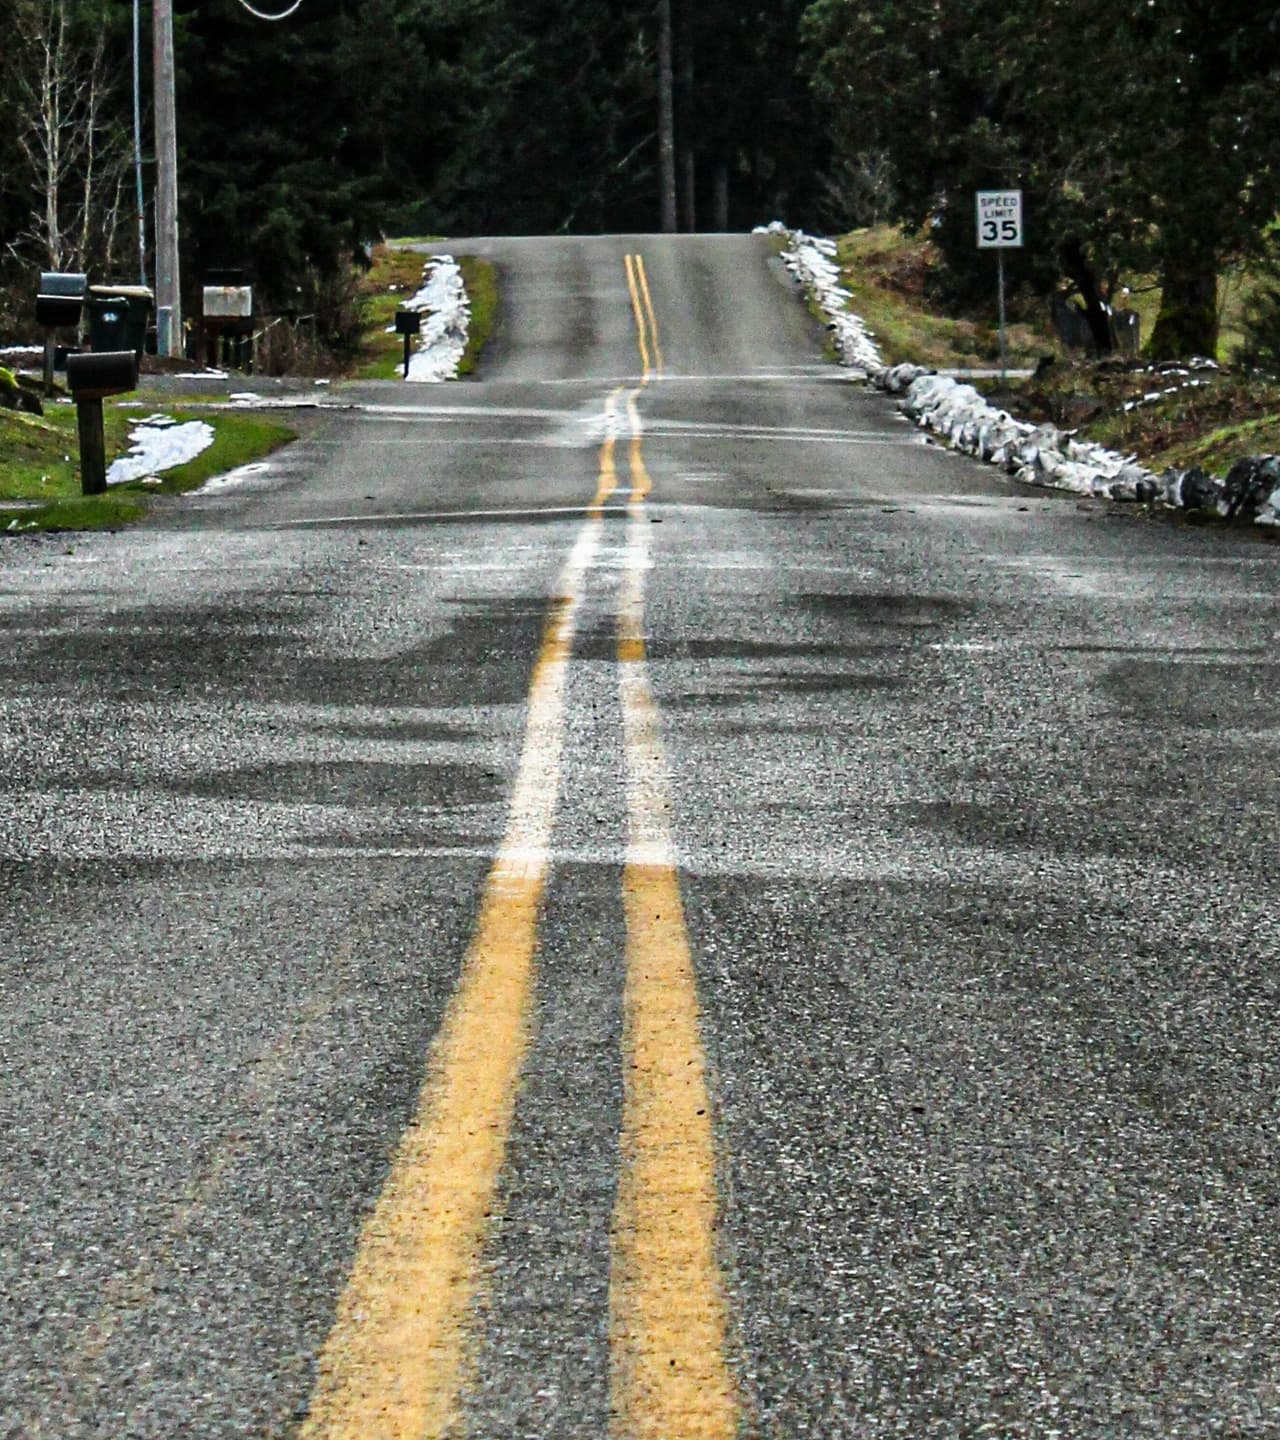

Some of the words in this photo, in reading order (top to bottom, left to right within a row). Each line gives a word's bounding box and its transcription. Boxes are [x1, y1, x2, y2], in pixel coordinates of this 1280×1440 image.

[980, 198, 1017, 207] SPEED
[984, 209, 1013, 219] LIMIT
[983, 221, 1018, 241] 35
